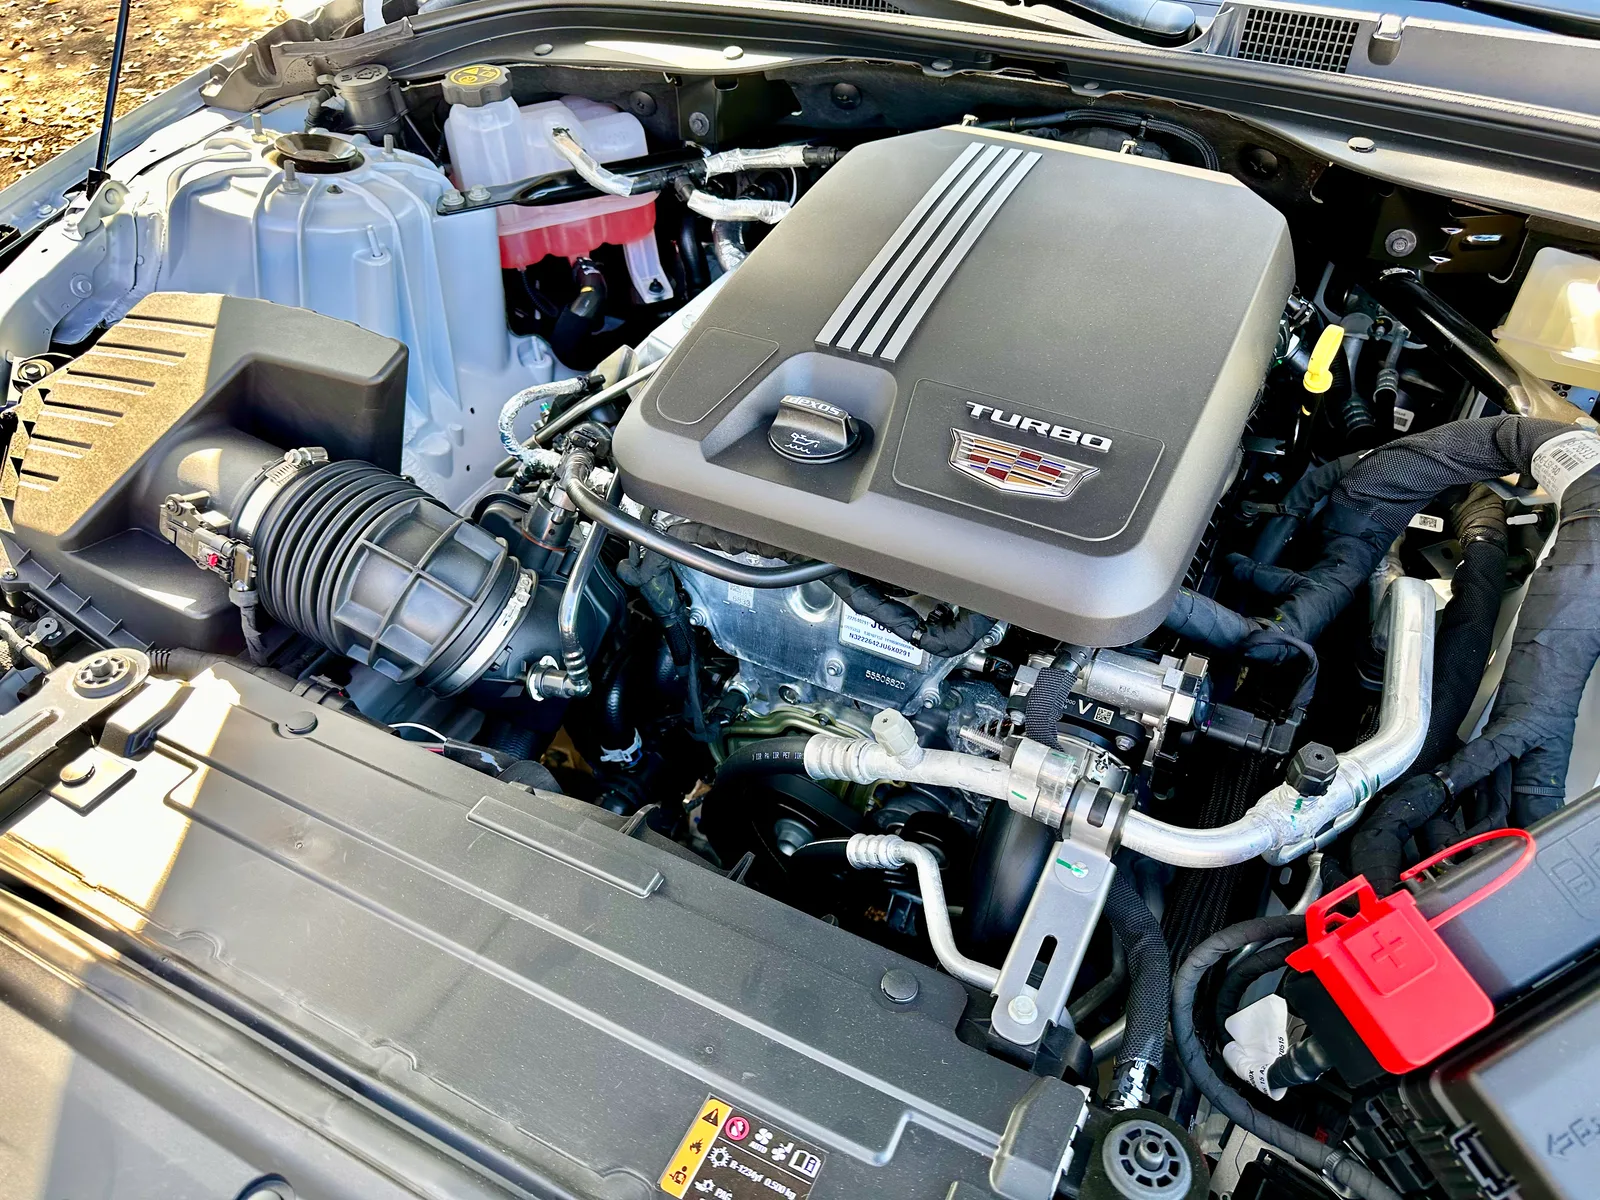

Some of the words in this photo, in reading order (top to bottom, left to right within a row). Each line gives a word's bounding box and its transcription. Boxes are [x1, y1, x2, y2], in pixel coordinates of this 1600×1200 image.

[787, 396, 842, 416] dexos
[966, 401, 1113, 454] TURBO
[1078, 699, 1094, 715] V
